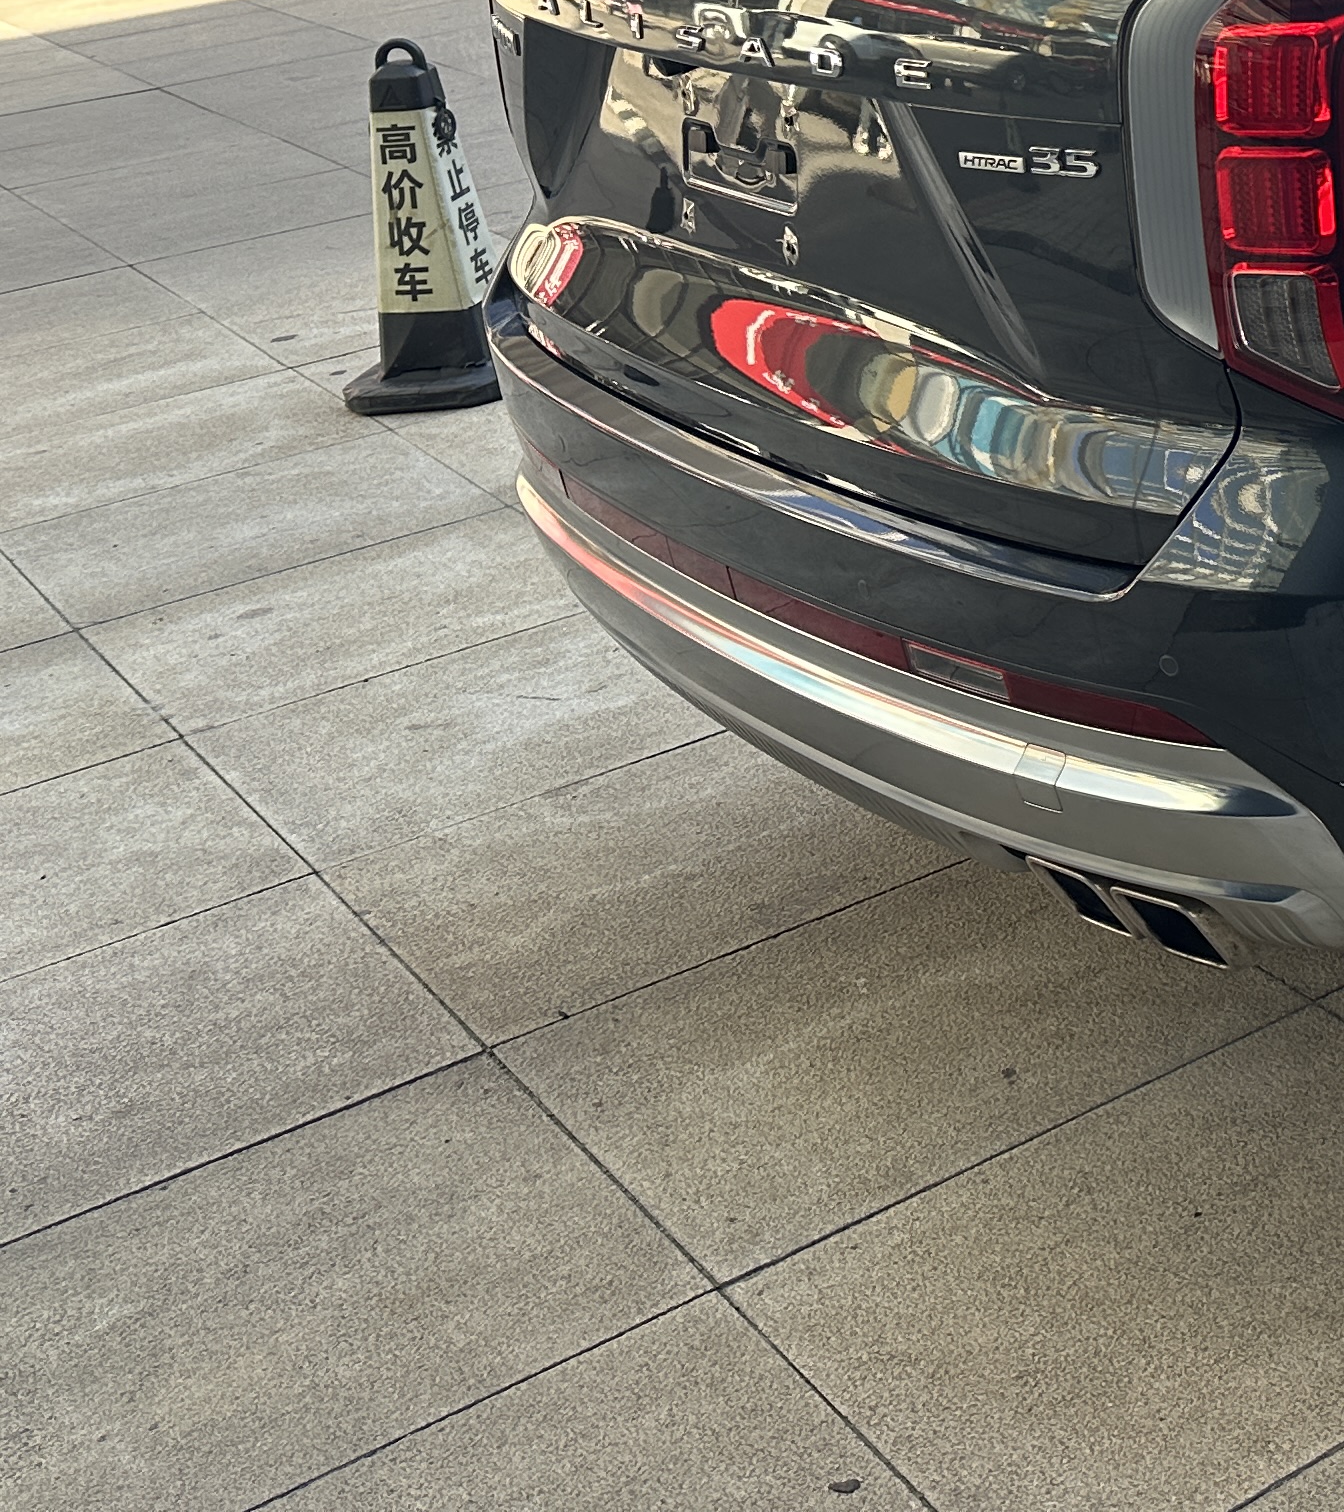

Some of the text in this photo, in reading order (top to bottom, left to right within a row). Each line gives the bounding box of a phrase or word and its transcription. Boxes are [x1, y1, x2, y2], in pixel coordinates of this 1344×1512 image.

[962, 154, 1020, 171] HTRAC
[376, 123, 433, 302] 高价收车
